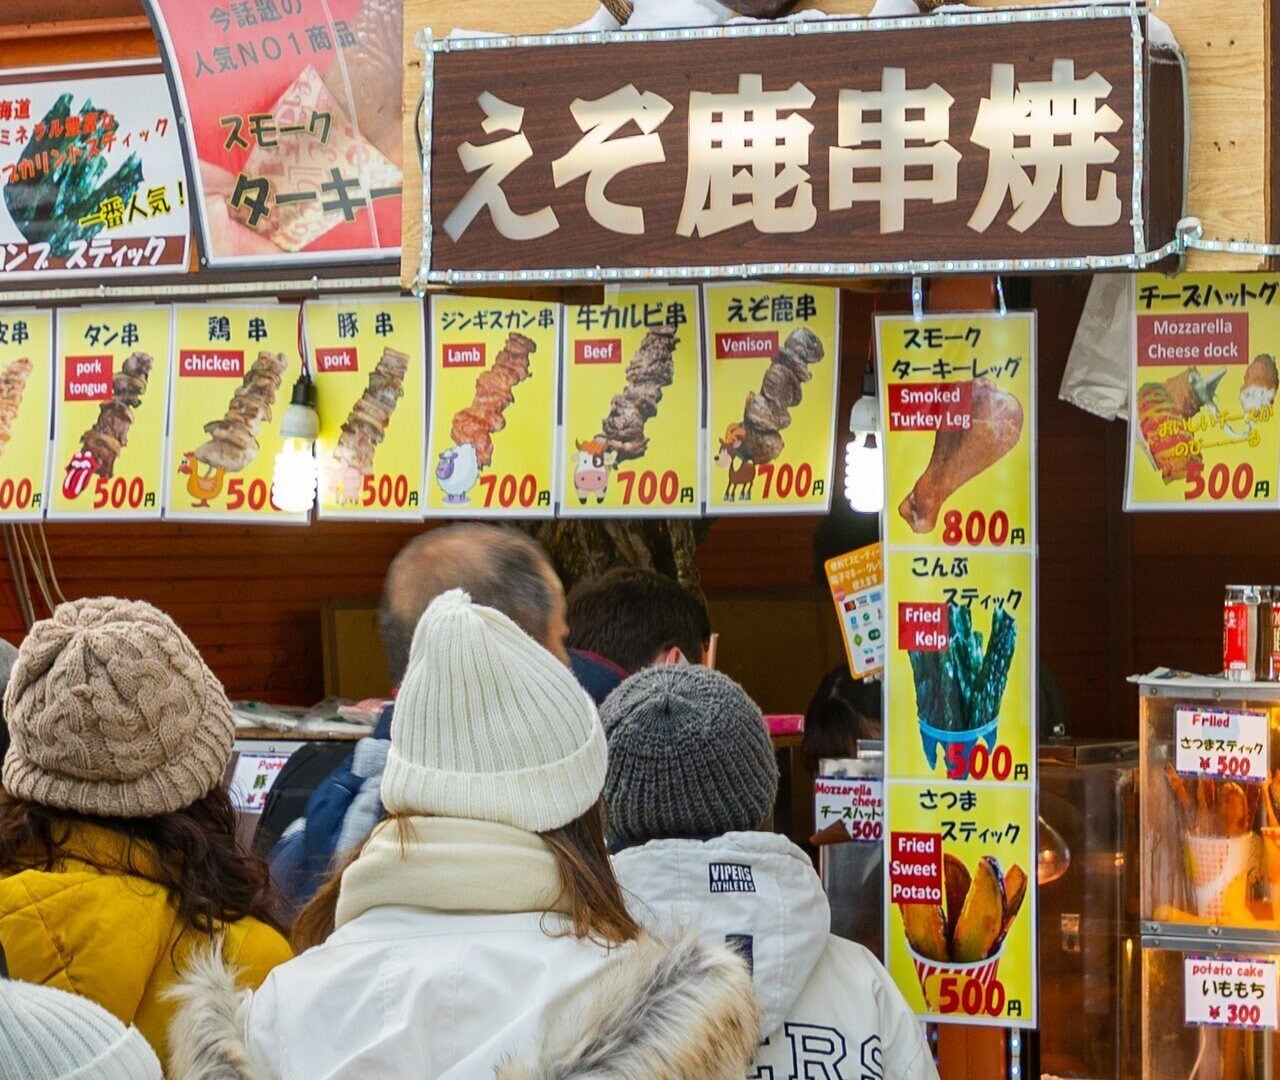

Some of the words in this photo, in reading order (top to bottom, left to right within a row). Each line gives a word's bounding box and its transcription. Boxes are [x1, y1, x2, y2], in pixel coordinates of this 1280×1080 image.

[220, 110, 333, 152] スモーク
[441, 59, 1124, 244] えぞ鹿串焼
[228, 166, 403, 228] ターキー
[1139, 281, 1279, 309] チーズハットグ
[577, 302, 687, 330] 牛カルビ串
[727, 294, 818, 323] えぞ鹿串
[441, 308, 555, 331] ジンギスカン串
[1153, 320, 1233, 335] Mozzarella
[84, 323, 140, 348] タン串
[721, 336, 773, 354] Venison
[903, 327, 982, 349] スモーク
[323, 351, 351, 370] pork
[447, 347, 481, 364] Lamb
[584, 342, 614, 360] Beef
[1148, 343, 1201, 358] Cheese
[1204, 342, 1238, 358] dock
[76, 360, 102, 378] pork
[184, 355, 240, 372] chicken
[892, 356, 1022, 379] ターキーレッグ
[69, 381, 108, 398] tongue
[900, 388, 960, 404] Smoked
[891, 411, 943, 429] Turkey
[946, 411, 970, 429] Leg
[362, 474, 419, 508] 500円
[479, 474, 551, 508] 700円
[617, 470, 694, 506] 700円
[757, 463, 825, 500] 700円
[1184, 463, 1269, 500] 500円
[93, 477, 156, 509] 500円
[942, 509, 1025, 547] 800円
[911, 557, 968, 578] こんぶ
[942, 588, 1022, 610] スティック
[905, 606, 941, 622] Fried
[915, 630, 947, 650] Kelp
[1181, 737, 1263, 755] さつまスティック
[946, 744, 1028, 781] 500円
[816, 782, 872, 796] Mozzarella
[919, 790, 978, 811] さつま
[940, 820, 1020, 843] スティック
[897, 836, 934, 853] Fried
[711, 865, 751, 881] VIPERS
[892, 860, 937, 876] Sweet
[893, 883, 941, 900] Potato
[1193, 963, 1232, 976] potato
[1237, 965, 1264, 977] cake
[939, 977, 1022, 1017] 500円
[1202, 979, 1265, 999] いももち
